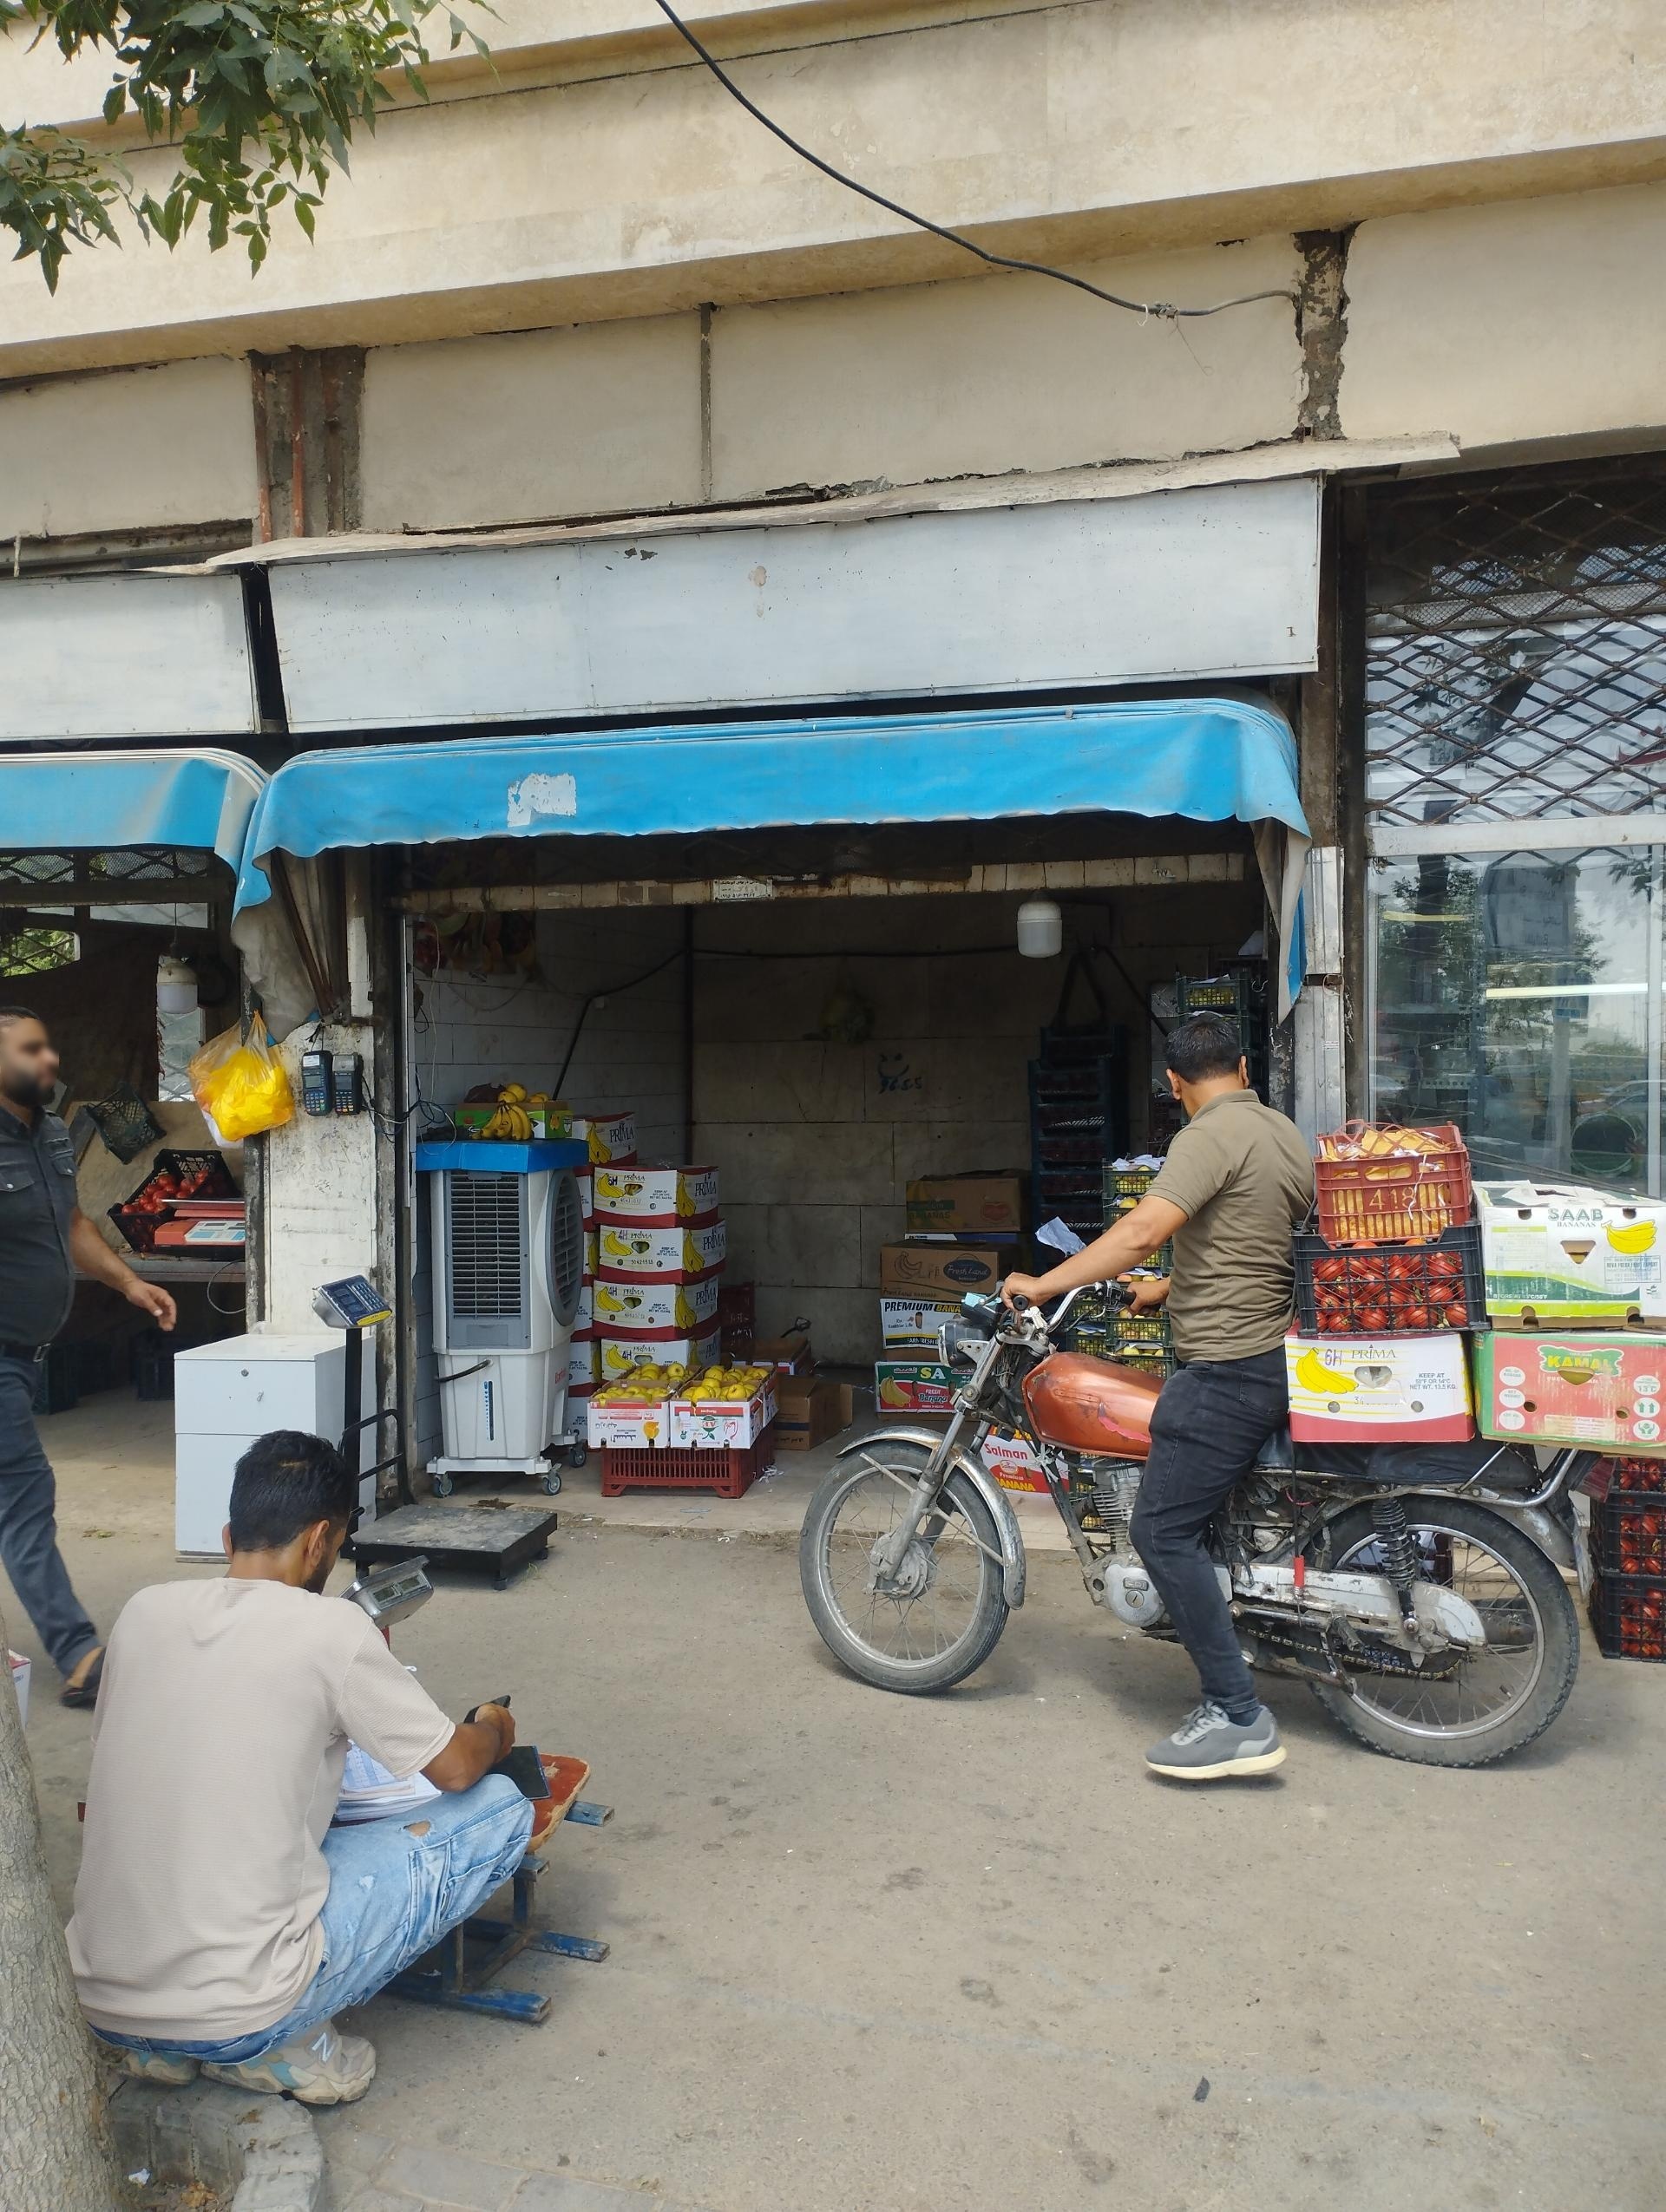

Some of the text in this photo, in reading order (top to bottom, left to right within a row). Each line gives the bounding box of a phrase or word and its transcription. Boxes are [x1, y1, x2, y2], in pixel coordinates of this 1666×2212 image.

[609, 1125, 634, 1142] PRIMA
[695, 1179, 717, 1196] PRIMA
[1548, 1207, 1604, 1221] SAAB
[703, 1231, 726, 1250] PRIMA
[696, 1286, 717, 1306] PRIMA
[885, 1301, 933, 1312] PREMIUM
[1352, 1346, 1397, 1359] PRIMA
[920, 1367, 946, 1379] SA
[918, 1394, 948, 1404] Banana
[984, 1443, 1028, 1460] Salman
[1000, 1471, 1025, 1481] Premium
[999, 1478, 1036, 1491] ANANA
